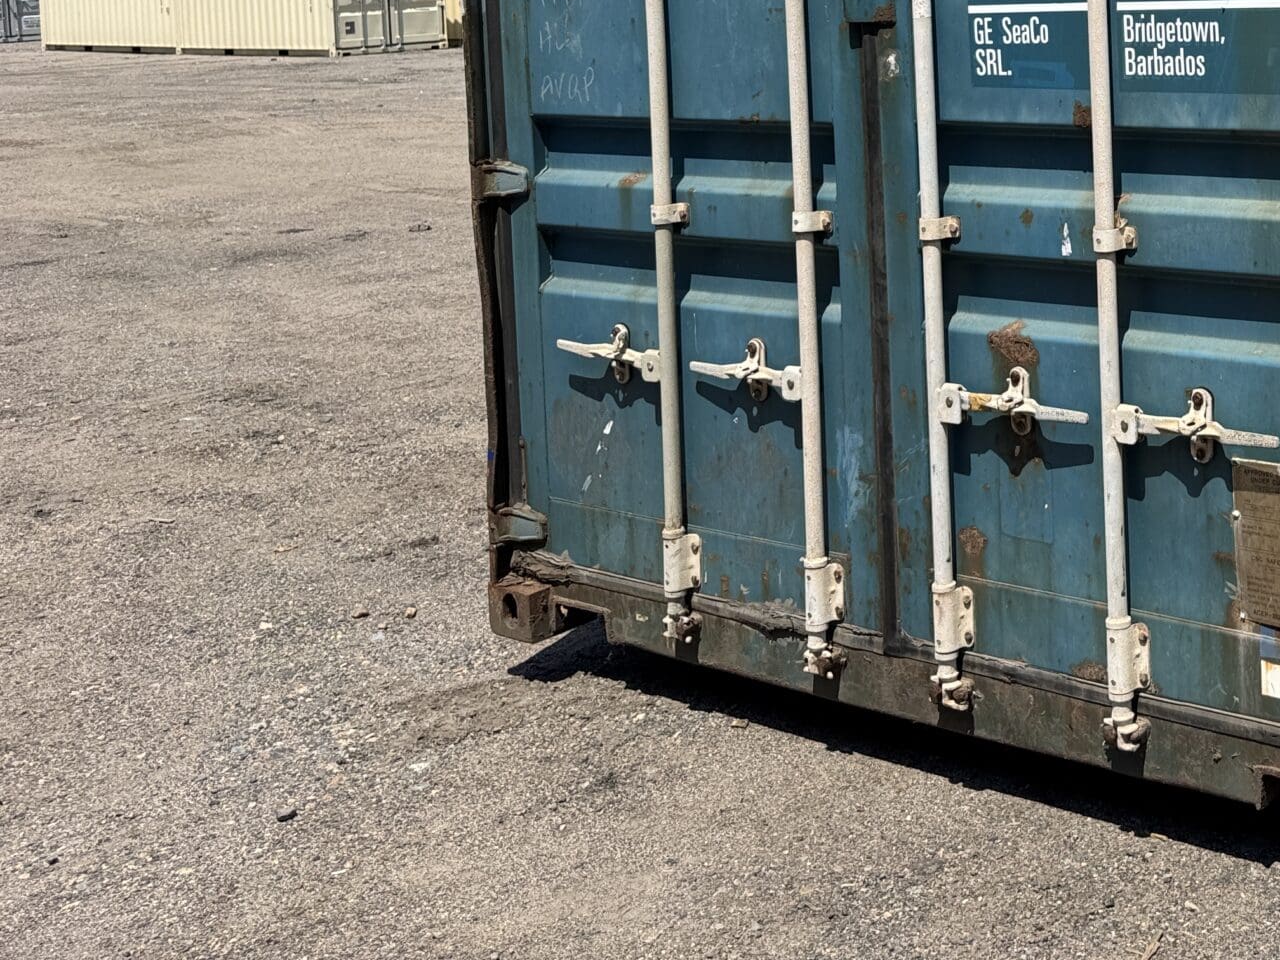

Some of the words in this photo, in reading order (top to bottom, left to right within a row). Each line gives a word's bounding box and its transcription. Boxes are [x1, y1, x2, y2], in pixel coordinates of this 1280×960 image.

[973, 17, 994, 45] GE
[1001, 16, 1049, 44] SeaCo
[1122, 14, 1226, 50] Bridgetown,
[975, 49, 1013, 77] SRL.
[1124, 47, 1206, 77] Barbados
